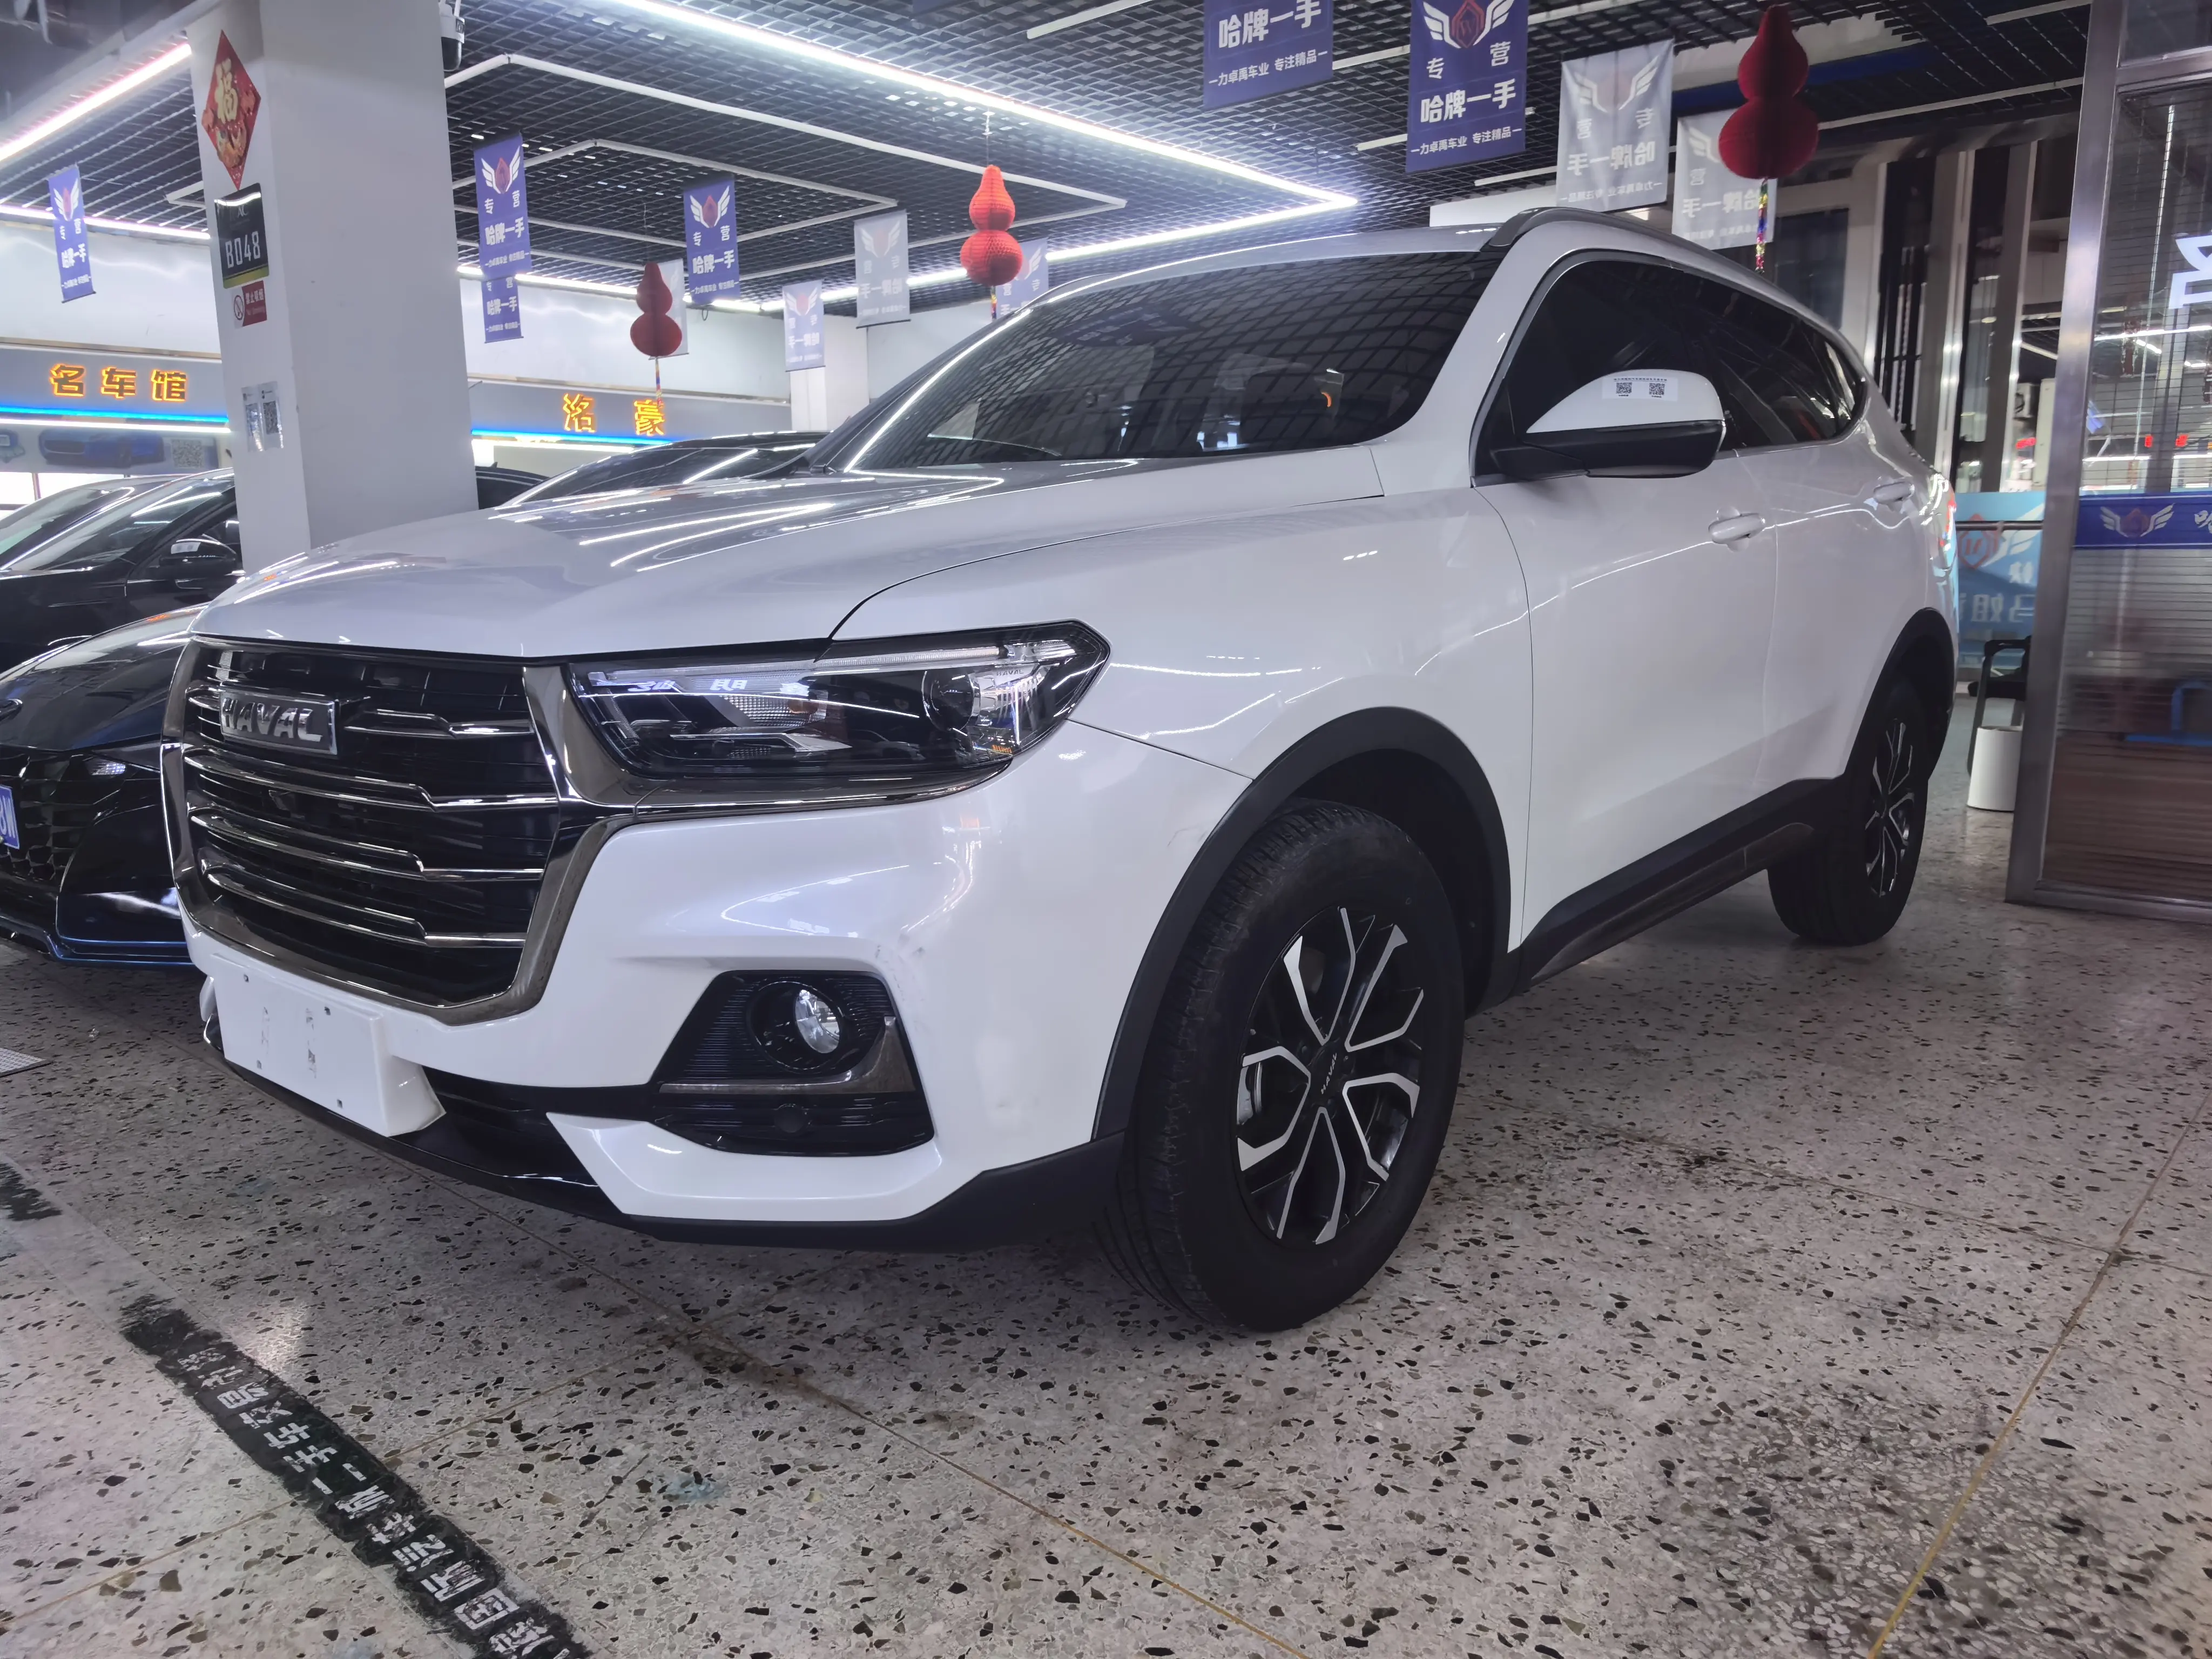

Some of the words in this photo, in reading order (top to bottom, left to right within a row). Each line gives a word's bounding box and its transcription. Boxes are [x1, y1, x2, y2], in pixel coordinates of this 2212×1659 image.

[1218, 0, 1322, 48] 哈牌一手
[1420, 78, 1516, 123] 哈牌一手
[485, 217, 525, 246] 哈牌一手
[692, 249, 736, 274] 哈牌一手
[49, 363, 187, 402] 名车馆
[221, 697, 322, 743] HAVAL
[1320, 1052, 1337, 1095] HAVAL
[177, 1347, 570, 1659] 滨国际汽车城二手车交易市场
